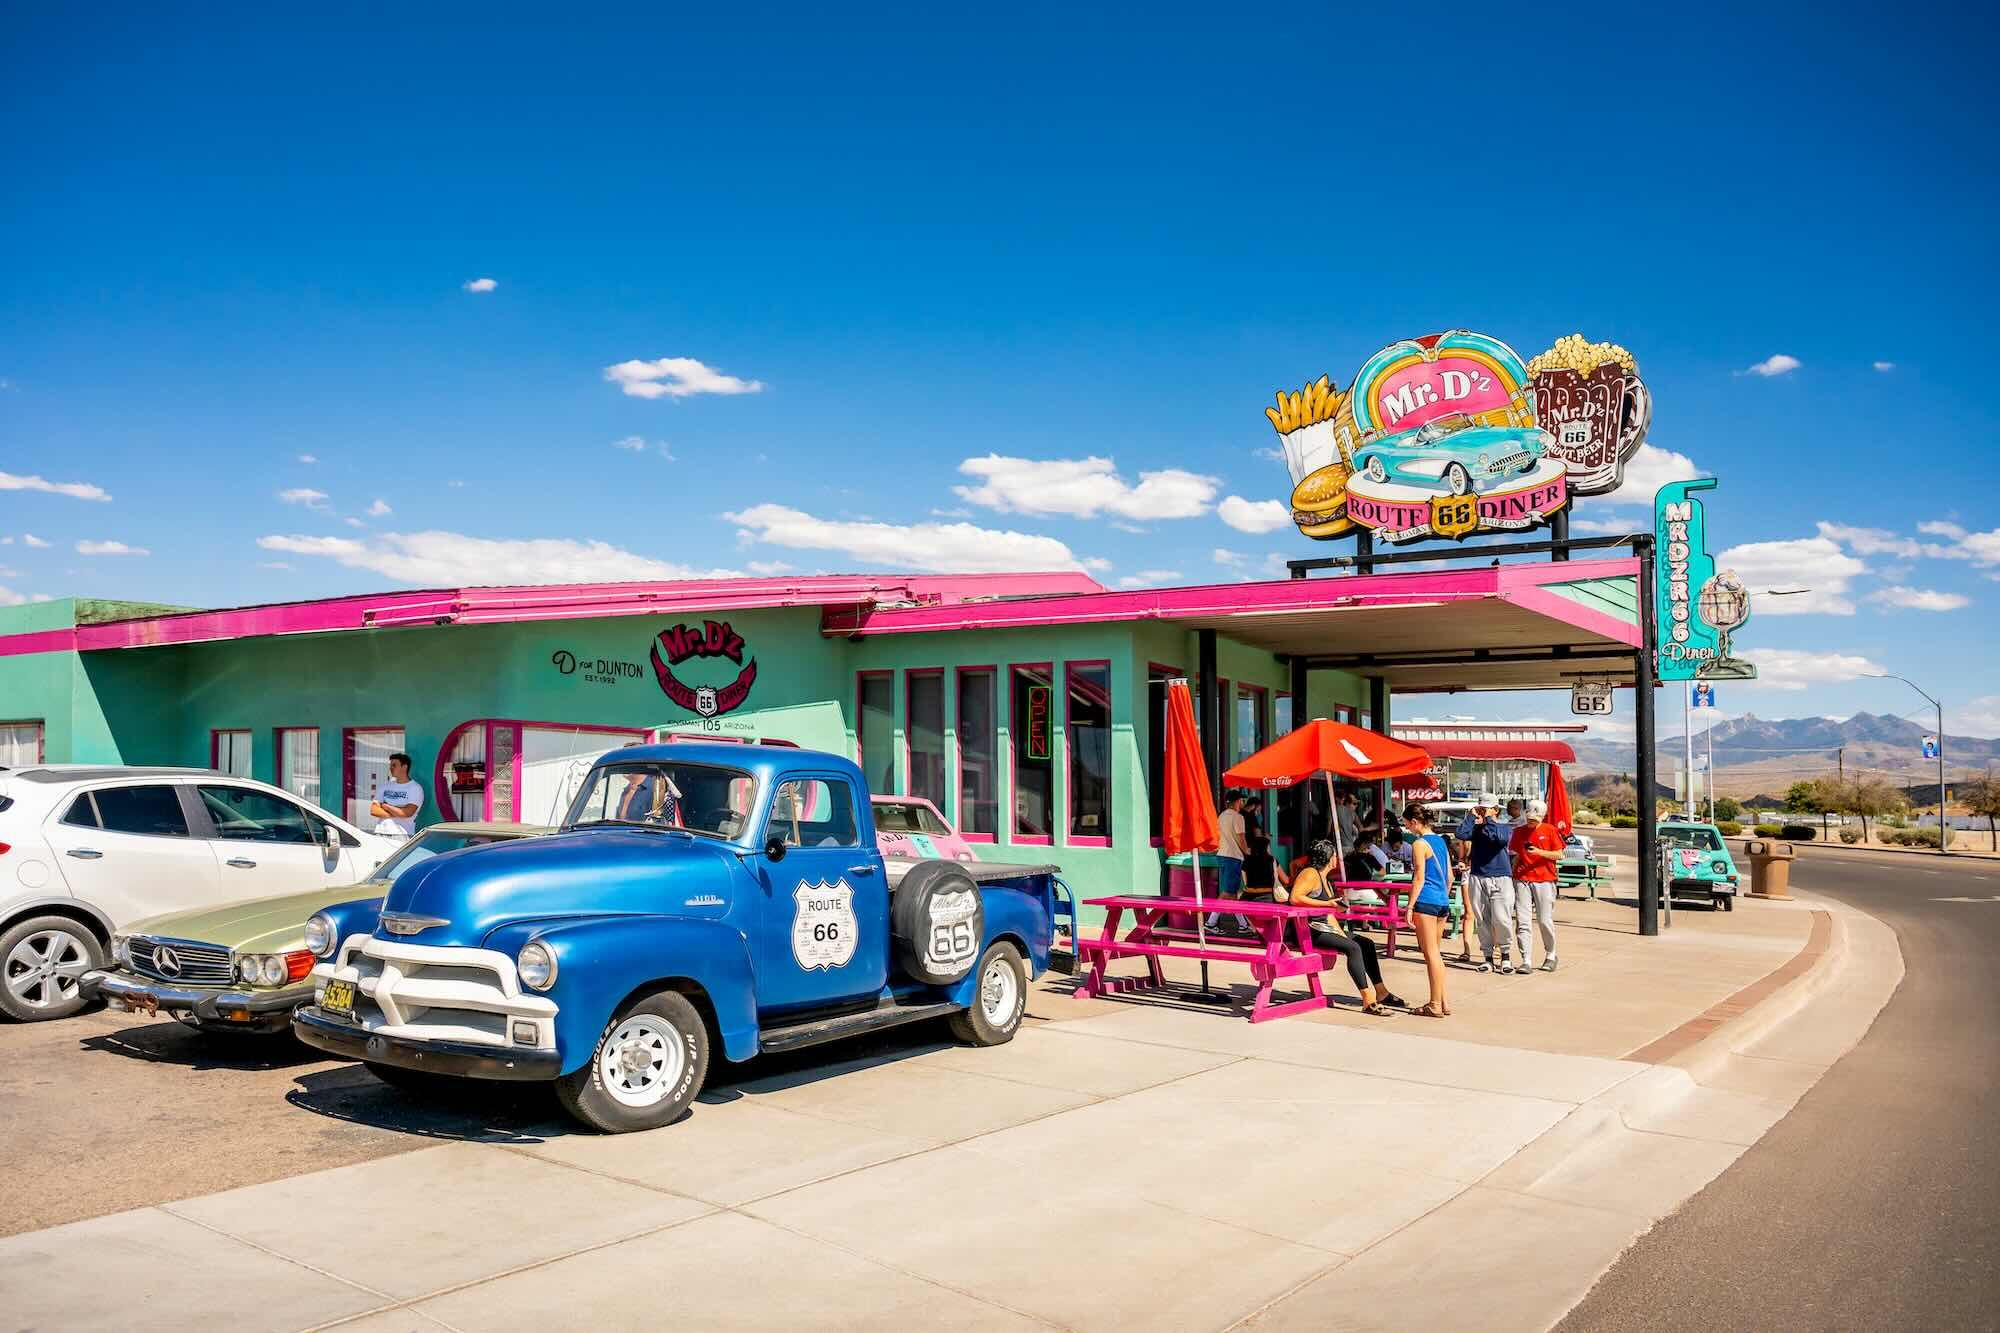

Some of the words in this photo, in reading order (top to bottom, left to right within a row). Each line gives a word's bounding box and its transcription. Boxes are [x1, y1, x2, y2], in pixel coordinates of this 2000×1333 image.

[1565, 431, 1586, 443] 66
[1576, 439, 1604, 459] BEER
[1350, 497, 1423, 529] ROUTE
[1438, 503, 1470, 526] 66
[1480, 485, 1559, 518] DINER
[1480, 518, 1528, 529] ARIZONA
[1661, 642, 1715, 661] Diner
[552, 650, 577, 675] D
[597, 659, 644, 679] DUNTON
[700, 696, 713, 709] 66
[1577, 696, 1605, 711] 66
[703, 719, 721, 731] 105
[724, 721, 755, 730] ARIZONA
[1031, 687, 1047, 755] OPEN
[1407, 787, 1444, 800] 2024
[808, 899, 842, 912] ROUTE
[813, 922, 839, 942] 66
[933, 921, 970, 956] 66
[674, 1064, 695, 1101] 4000
